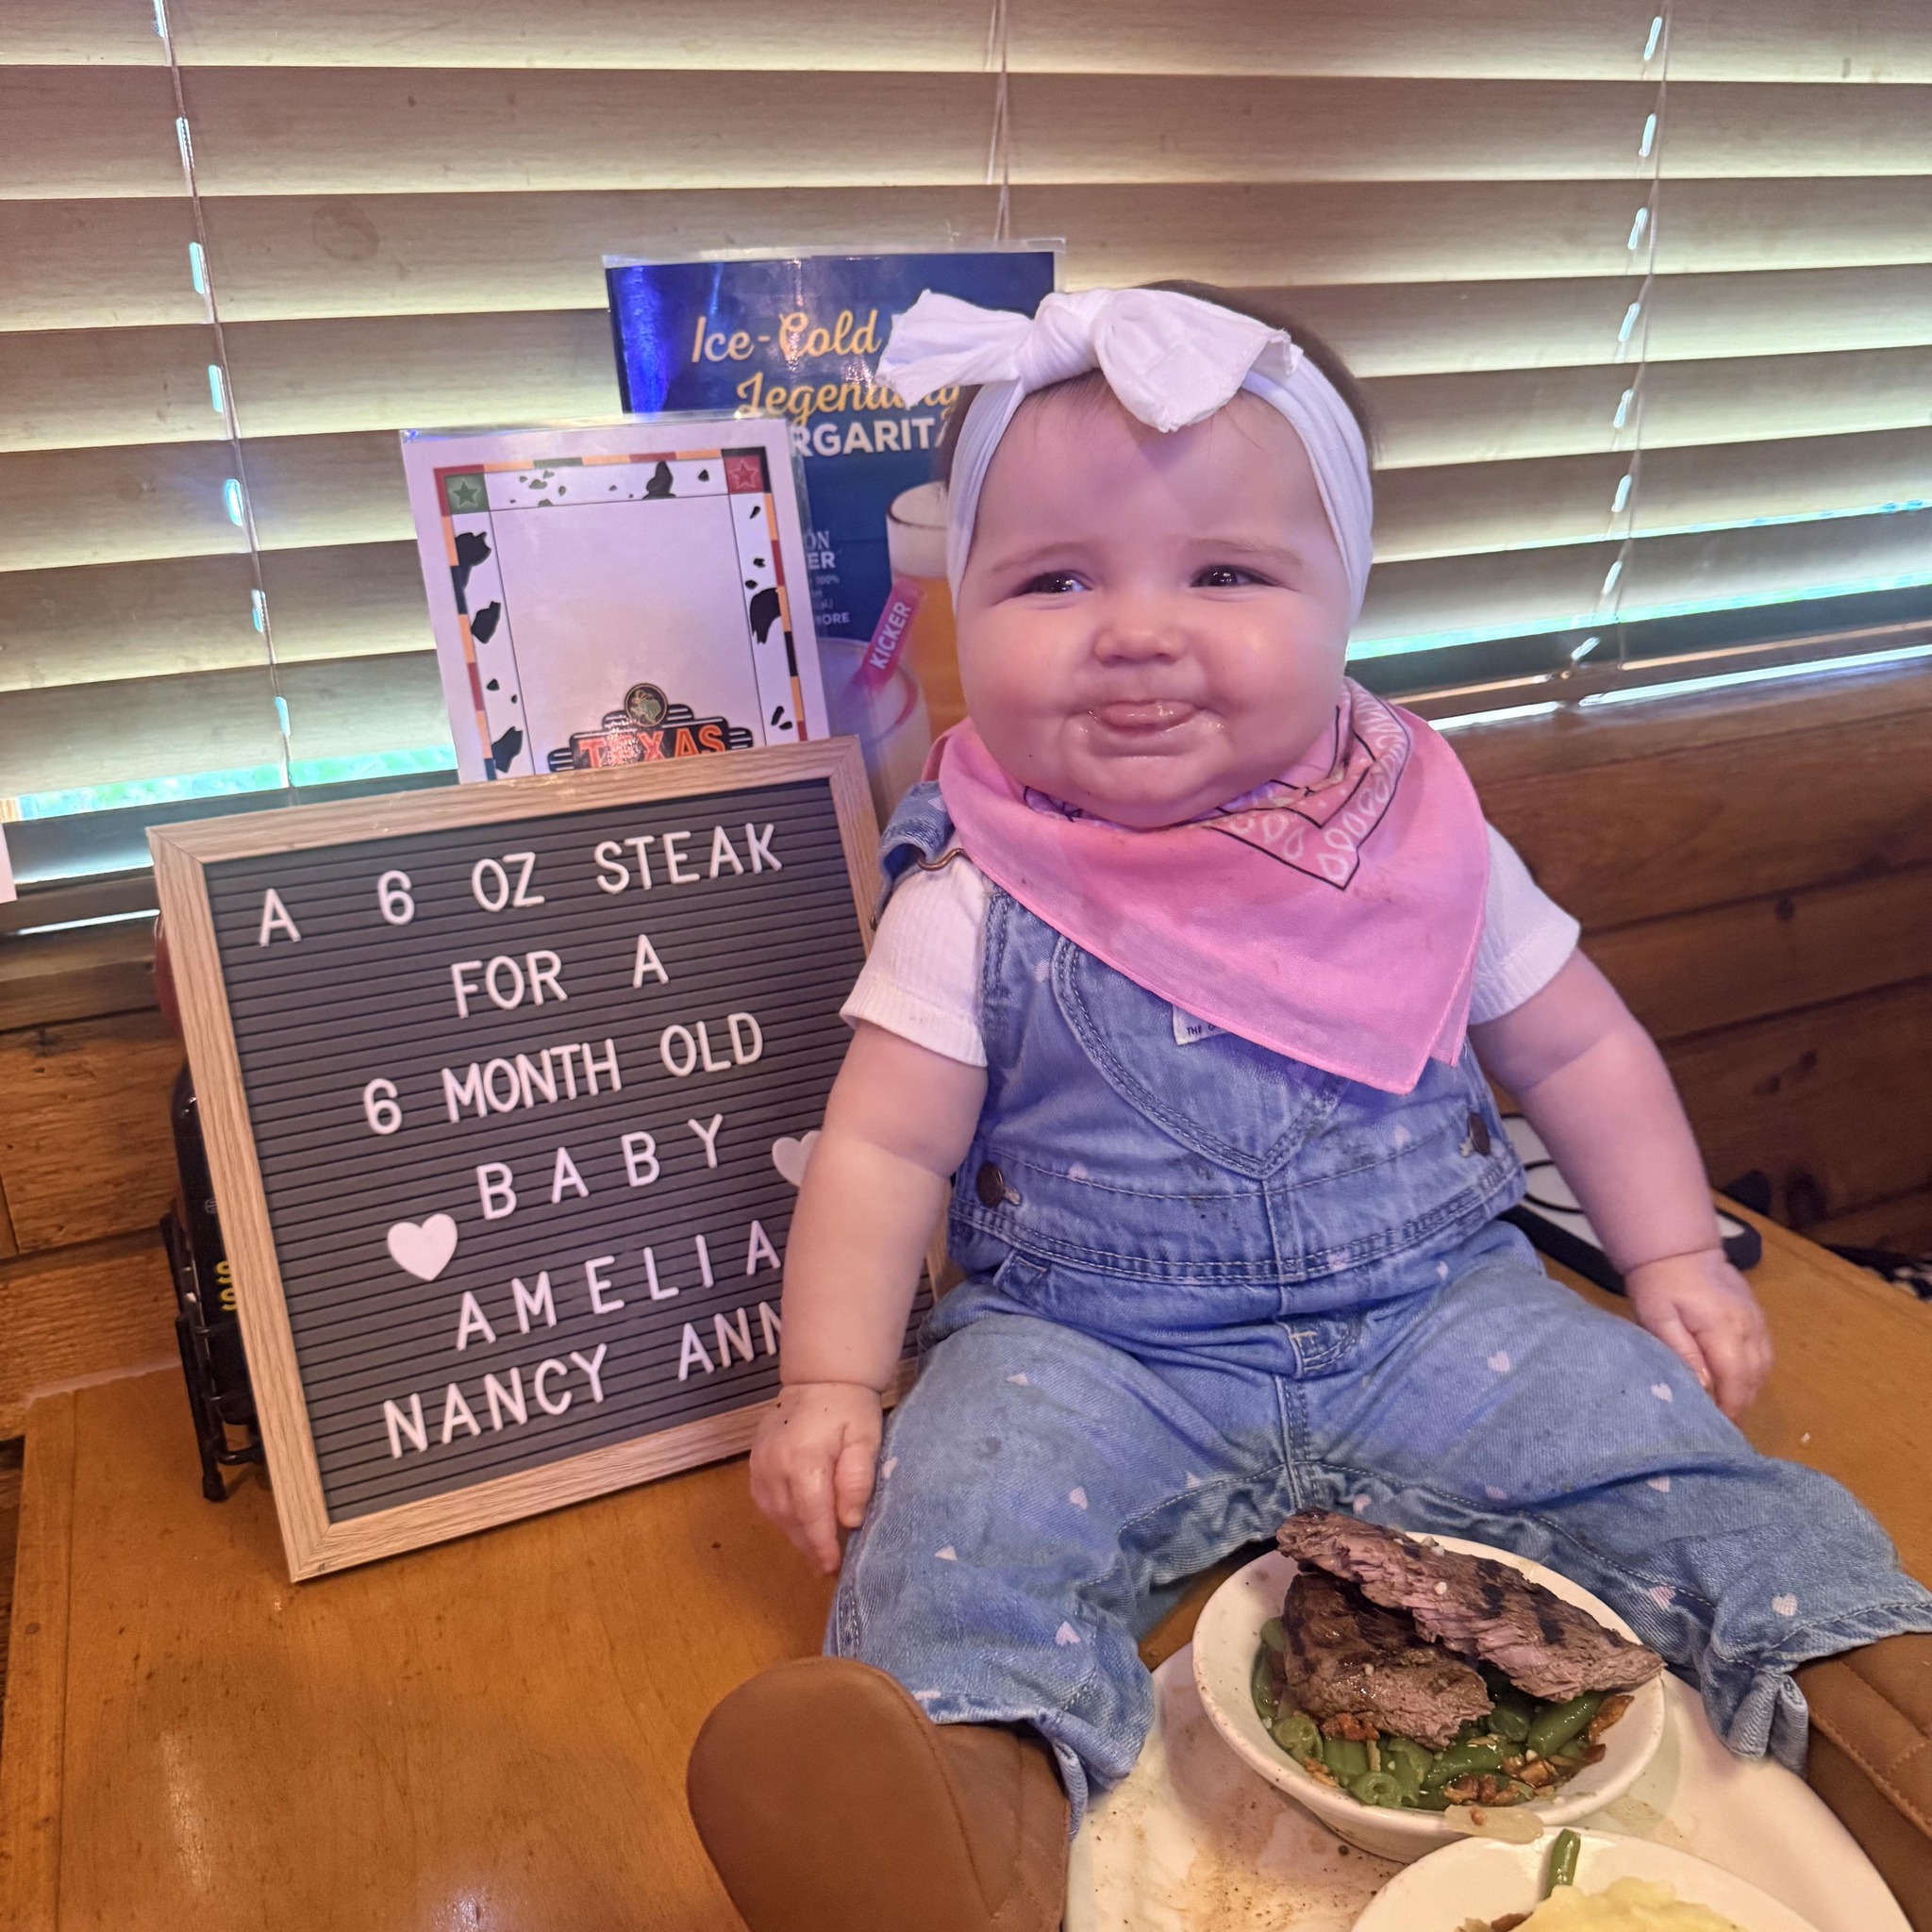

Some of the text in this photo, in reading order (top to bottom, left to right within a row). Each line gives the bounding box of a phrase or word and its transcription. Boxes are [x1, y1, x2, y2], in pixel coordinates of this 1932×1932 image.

[691, 308, 882, 364] Ice-Cold
[869, 600, 913, 671] KICKER
[258, 823, 783, 947] A 6 OZ STEAK
[450, 934, 670, 1019] FOR A
[363, 1012, 763, 1135] 6 MONTH OLD
[476, 1113, 724, 1221] BABY
[457, 1220, 782, 1353] AMELIA
[382, 1342, 609, 1458] NANCY
